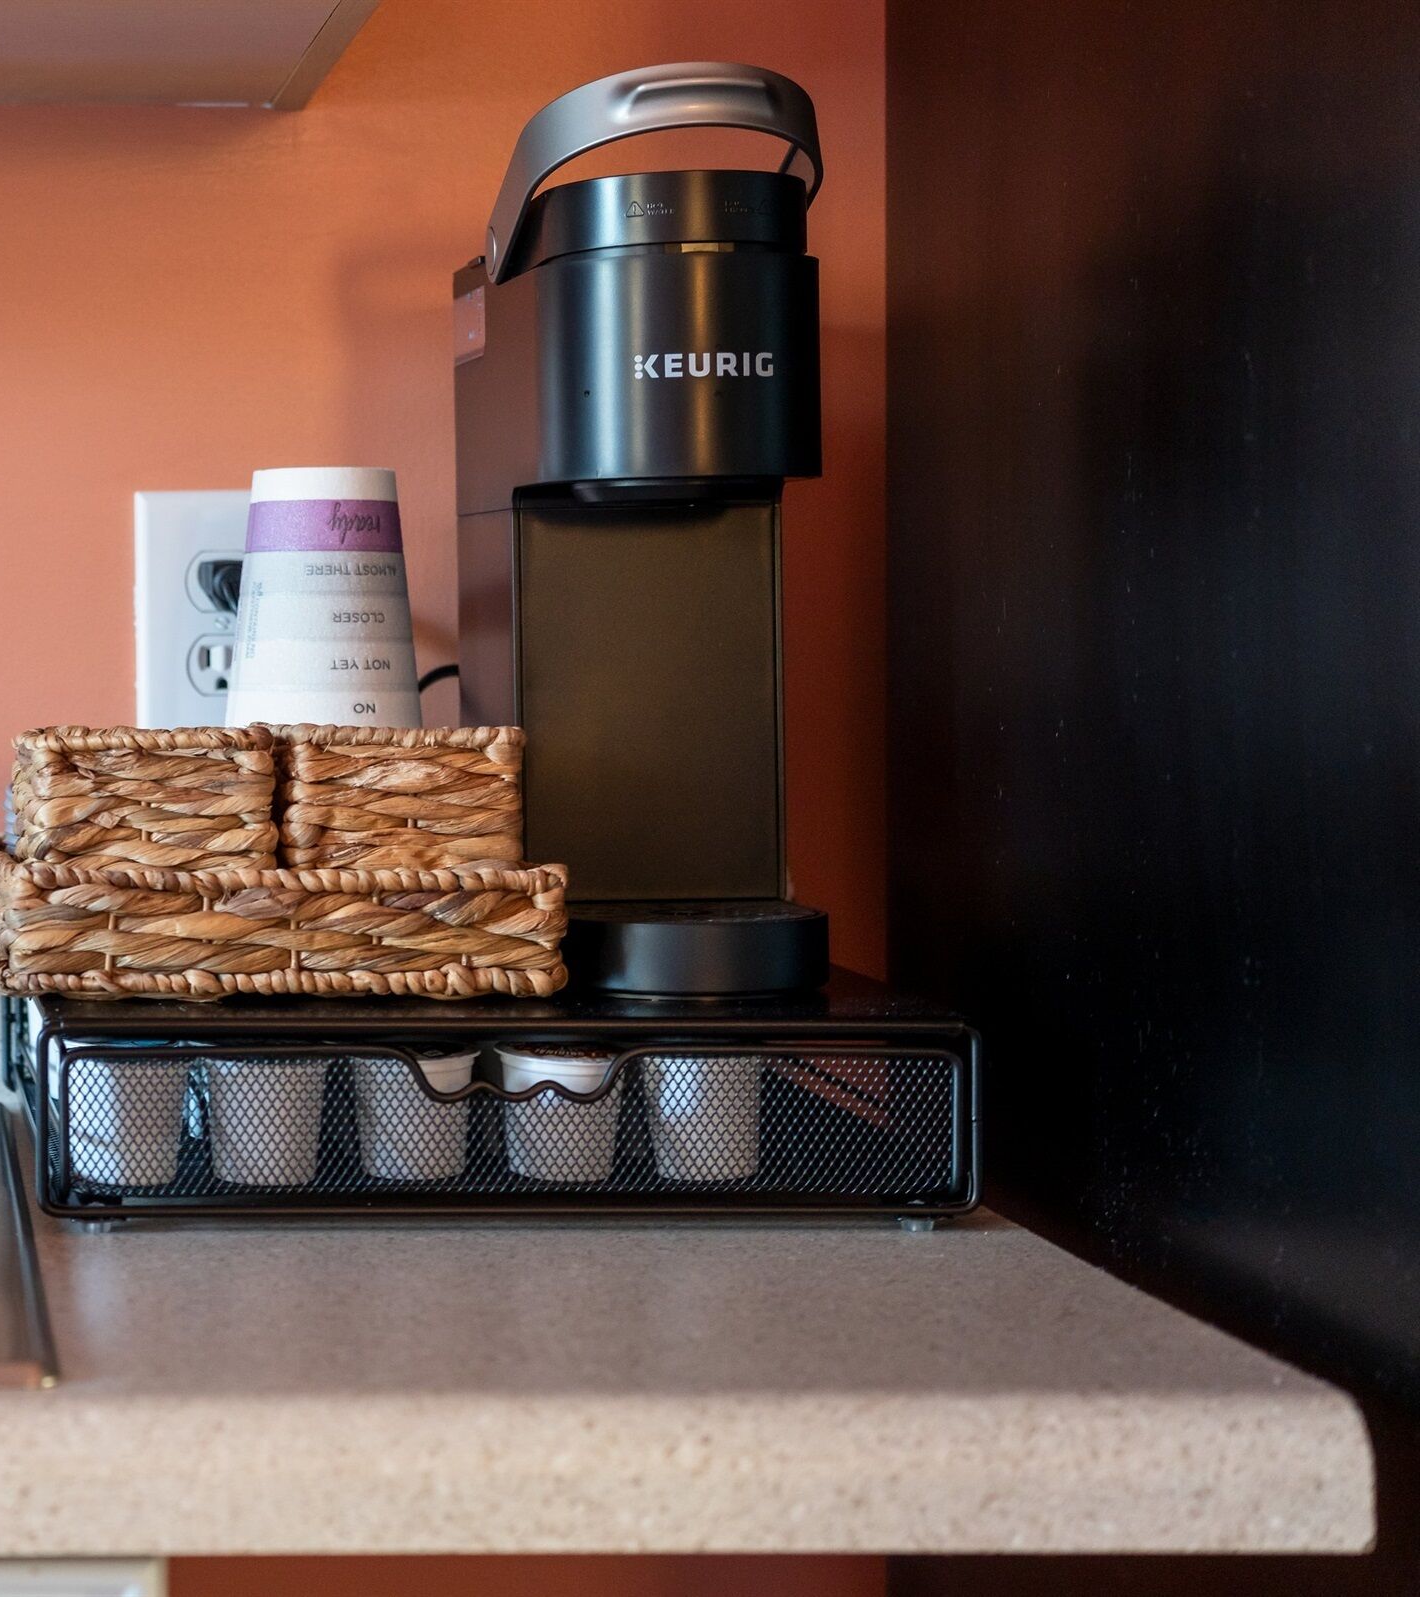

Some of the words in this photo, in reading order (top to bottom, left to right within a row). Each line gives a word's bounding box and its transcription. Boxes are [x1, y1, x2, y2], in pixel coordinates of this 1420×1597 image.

[634, 352, 774, 380] KEURIG
[327, 502, 381, 545] ready
[305, 564, 351, 576] THERE
[355, 564, 397, 576] ALMOST
[333, 612, 385, 623] CLOSER
[330, 659, 359, 670] YET
[364, 659, 391, 670] NOT
[353, 703, 376, 714] NO
